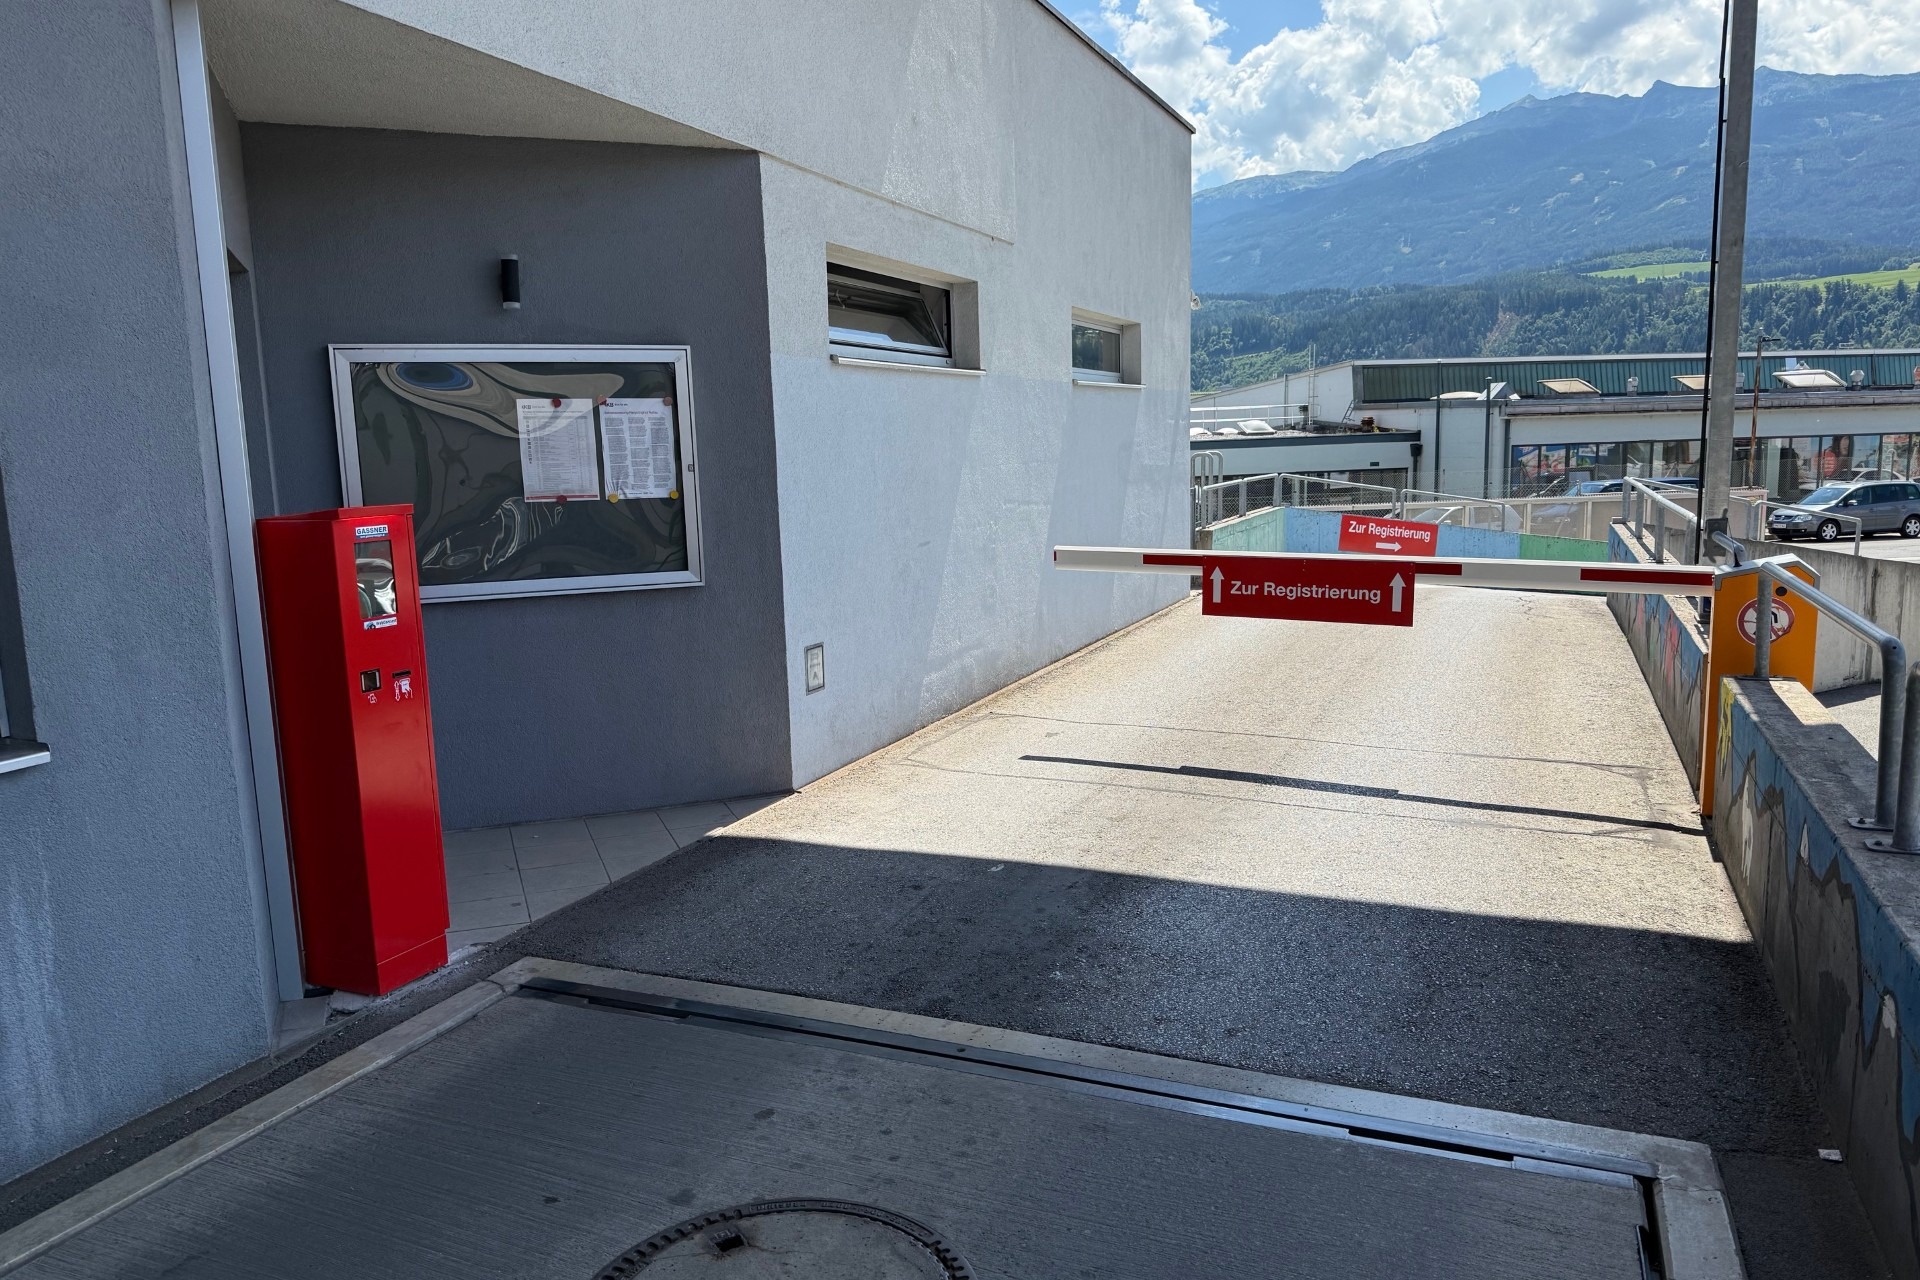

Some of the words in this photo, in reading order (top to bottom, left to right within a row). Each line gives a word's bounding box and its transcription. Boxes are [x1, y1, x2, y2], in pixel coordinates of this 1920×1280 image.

[356, 526, 387, 534] GASSNER
[1348, 521, 1366, 534] Zur
[1368, 522, 1431, 542] Registrierung
[1230, 580, 1259, 595] Zur
[1263, 581, 1381, 604] Registrierung
